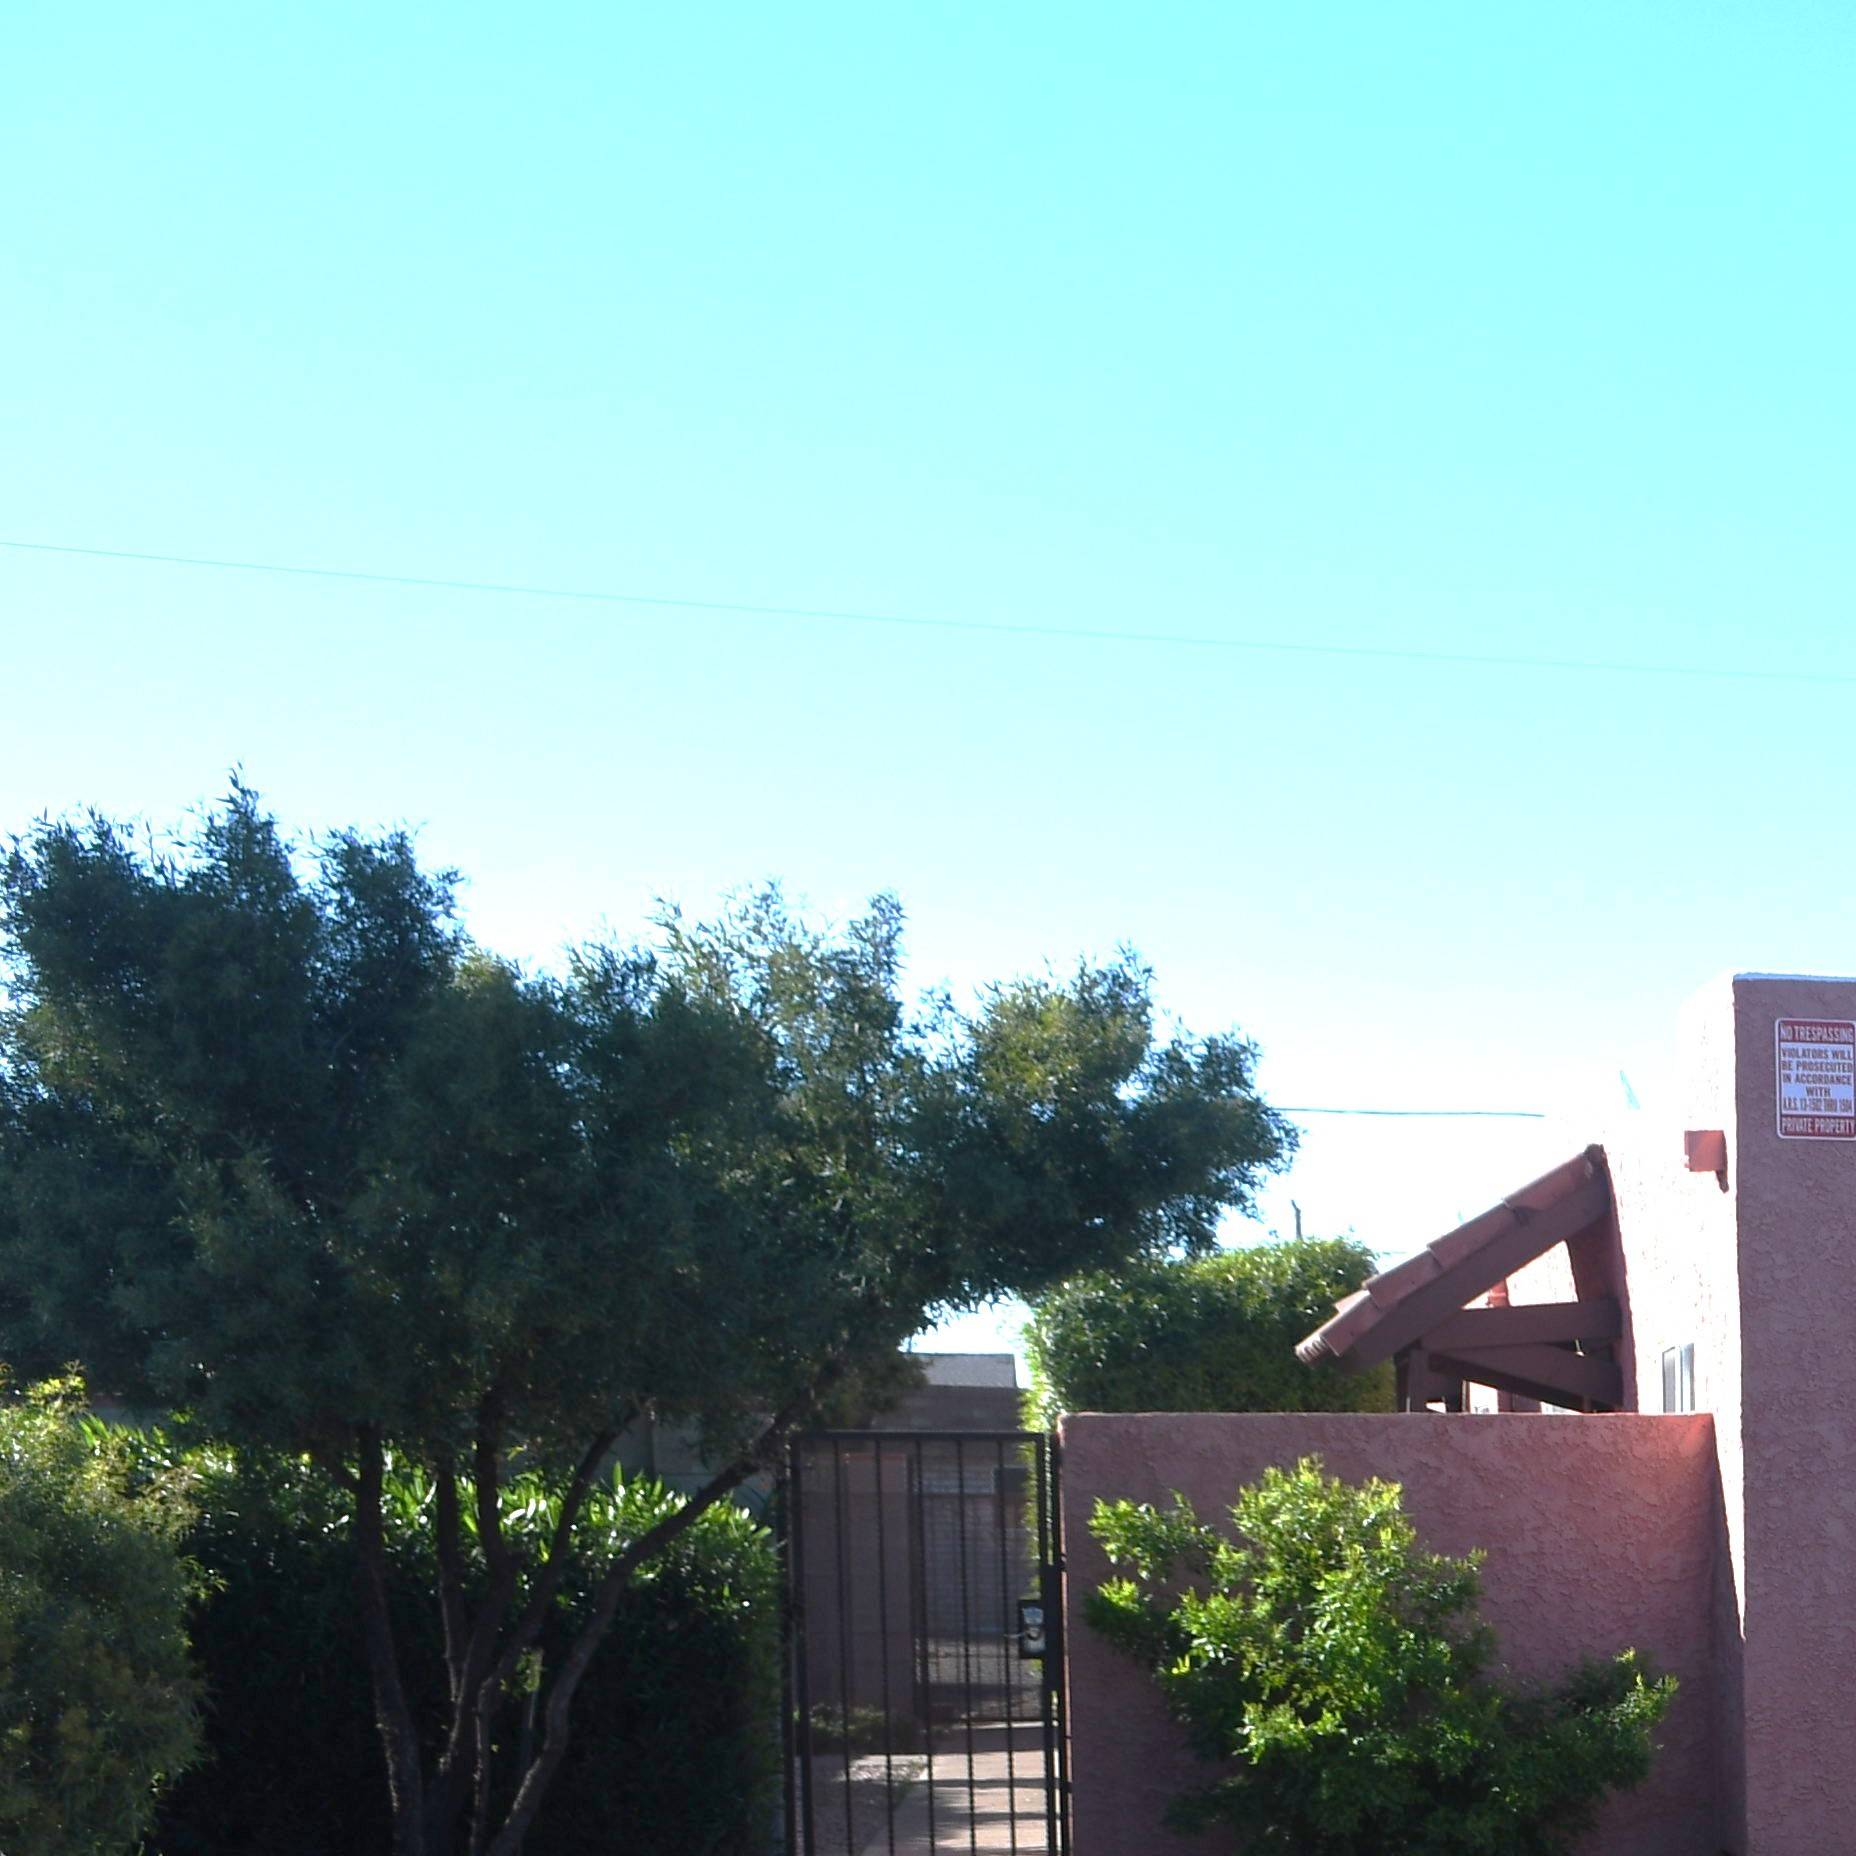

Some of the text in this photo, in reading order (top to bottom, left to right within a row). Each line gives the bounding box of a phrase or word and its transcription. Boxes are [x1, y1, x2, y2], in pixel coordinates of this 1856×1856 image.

[1780, 1025, 1854, 1042] NO TRESPASSING
[1781, 1047, 1853, 1060] VIOLATORS WILL
[1781, 1060, 1853, 1073] BE PROSECUTED
[1783, 1073, 1852, 1086] IN ACCORDANCE
[1805, 1086, 1831, 1097] WITH
[1782, 1117, 1856, 1135] PRIVATE PROPERTY
